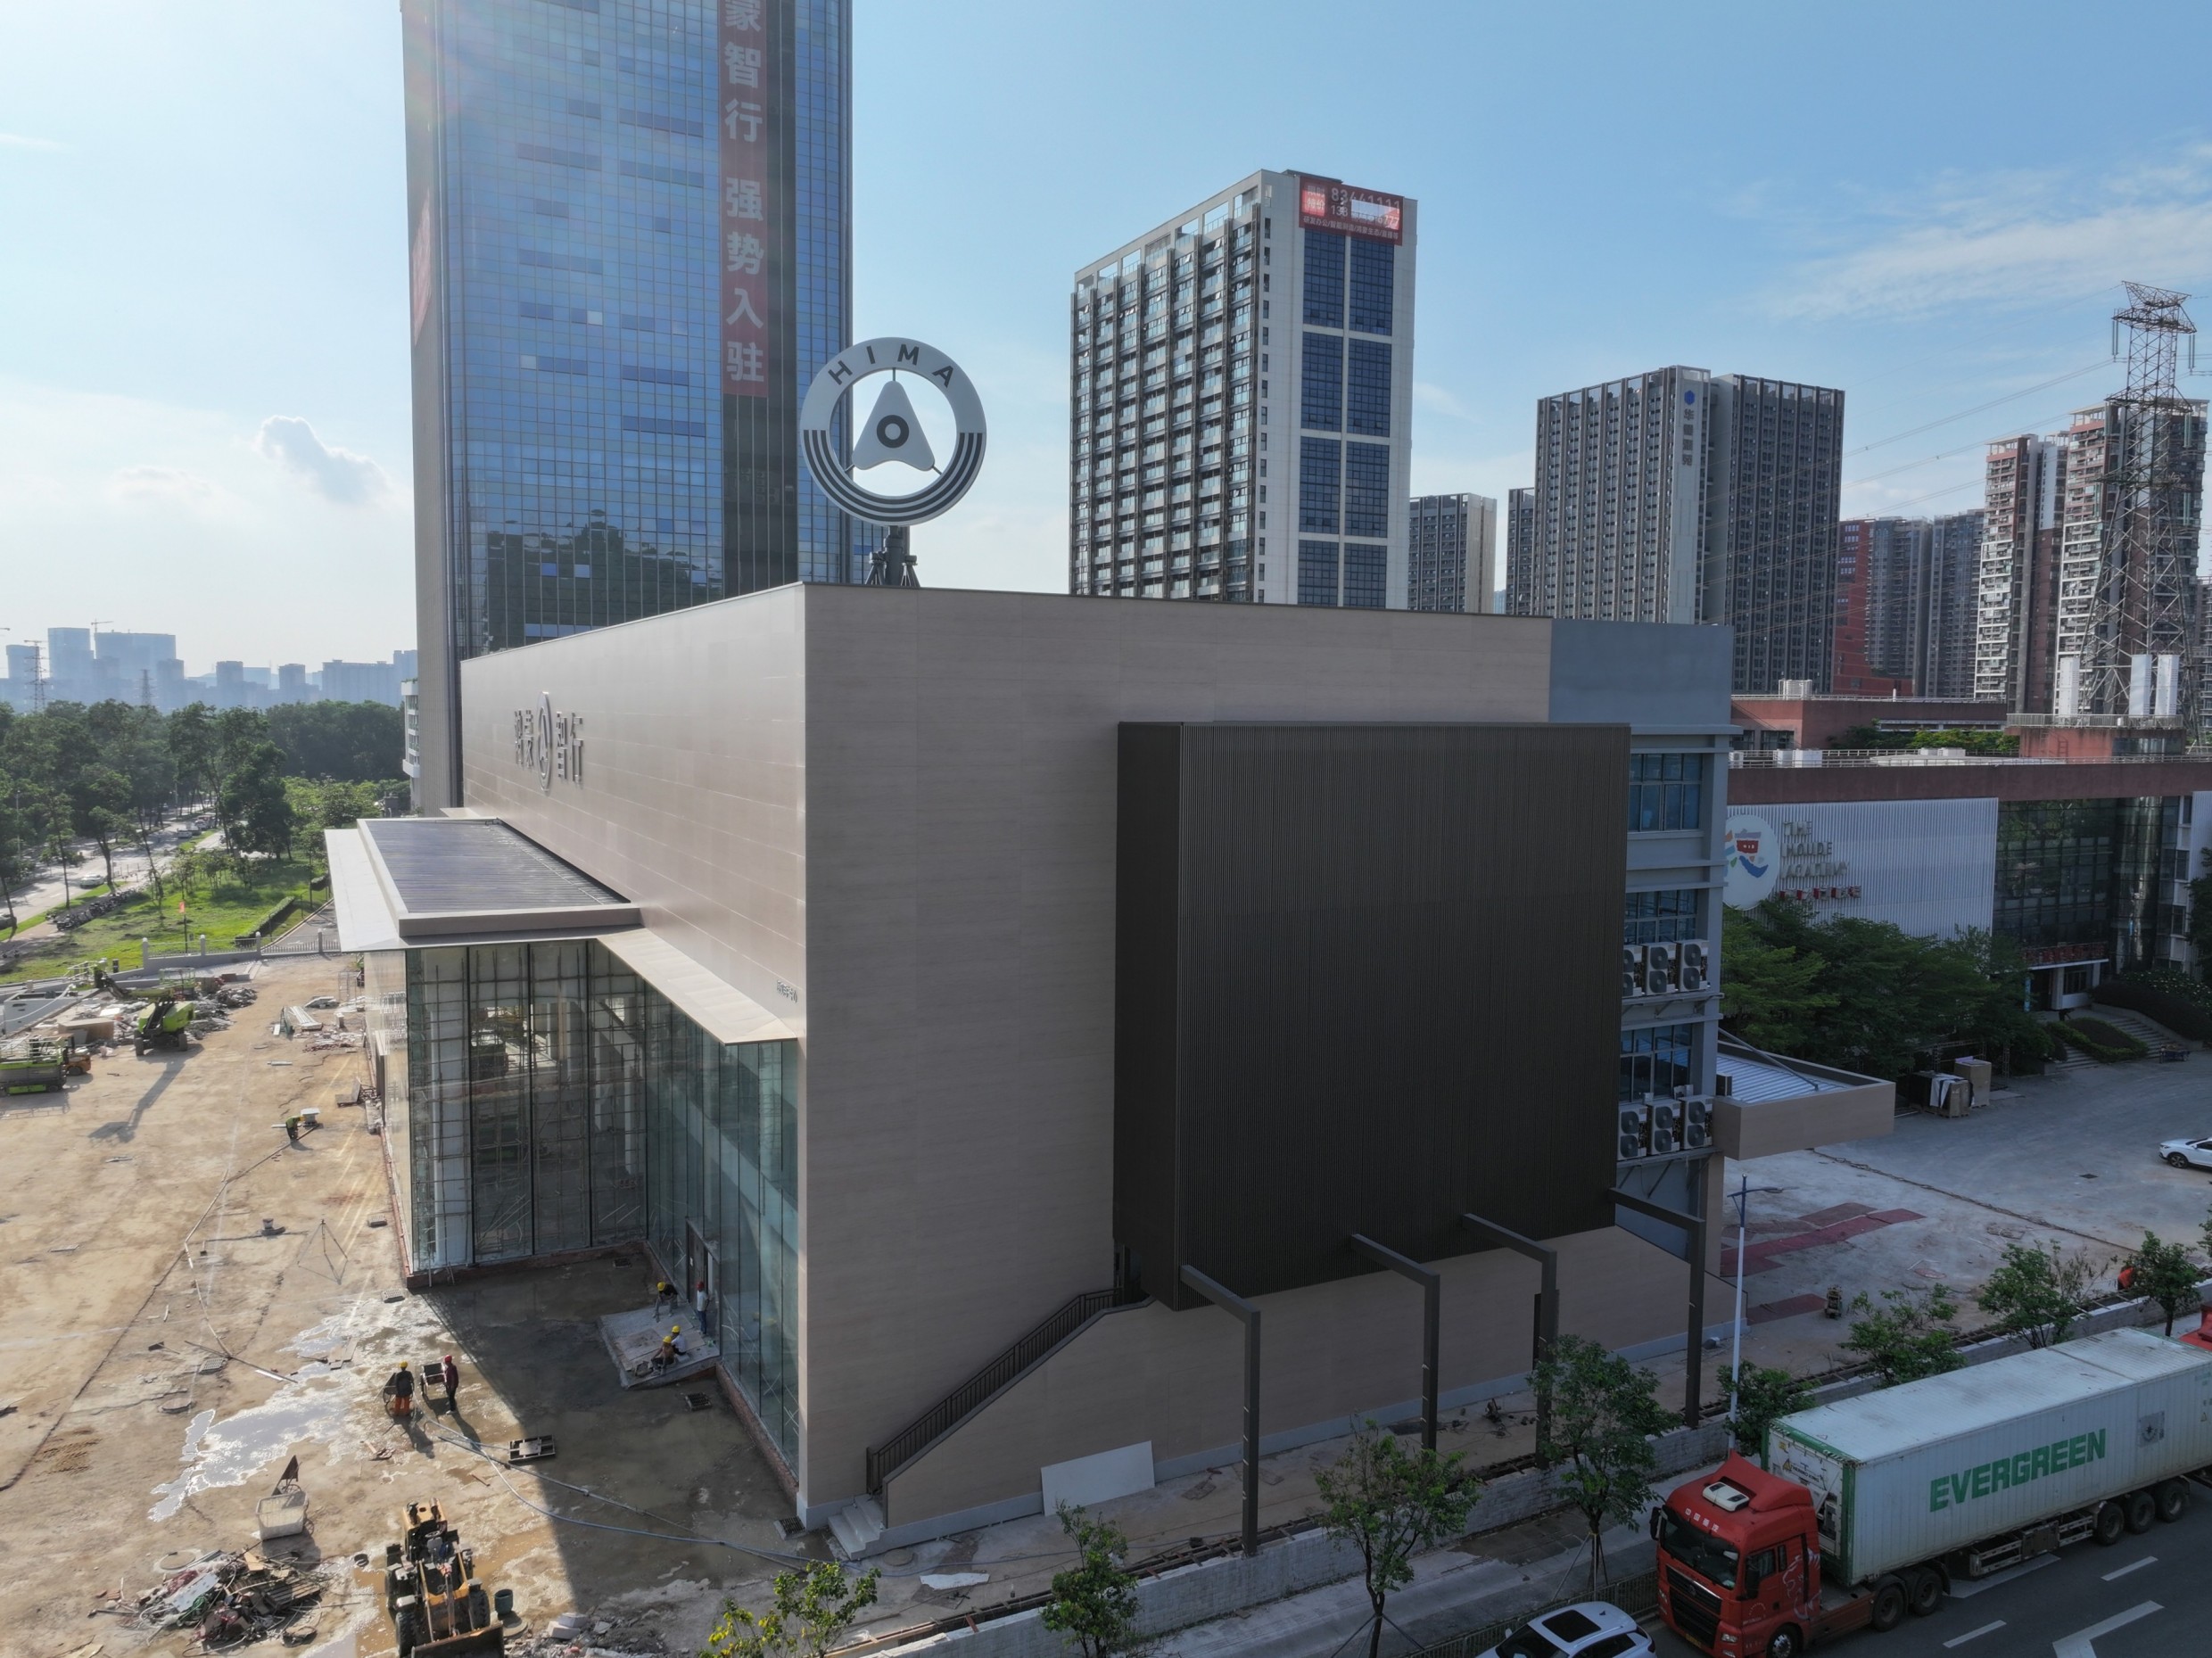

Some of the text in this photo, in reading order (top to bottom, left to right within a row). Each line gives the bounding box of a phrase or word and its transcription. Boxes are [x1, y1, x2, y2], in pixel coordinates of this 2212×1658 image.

[725, 177, 764, 383] 强势入驻
[828, 343, 953, 388] HIMA
[1929, 1428, 2106, 1513] EVERGREEN
